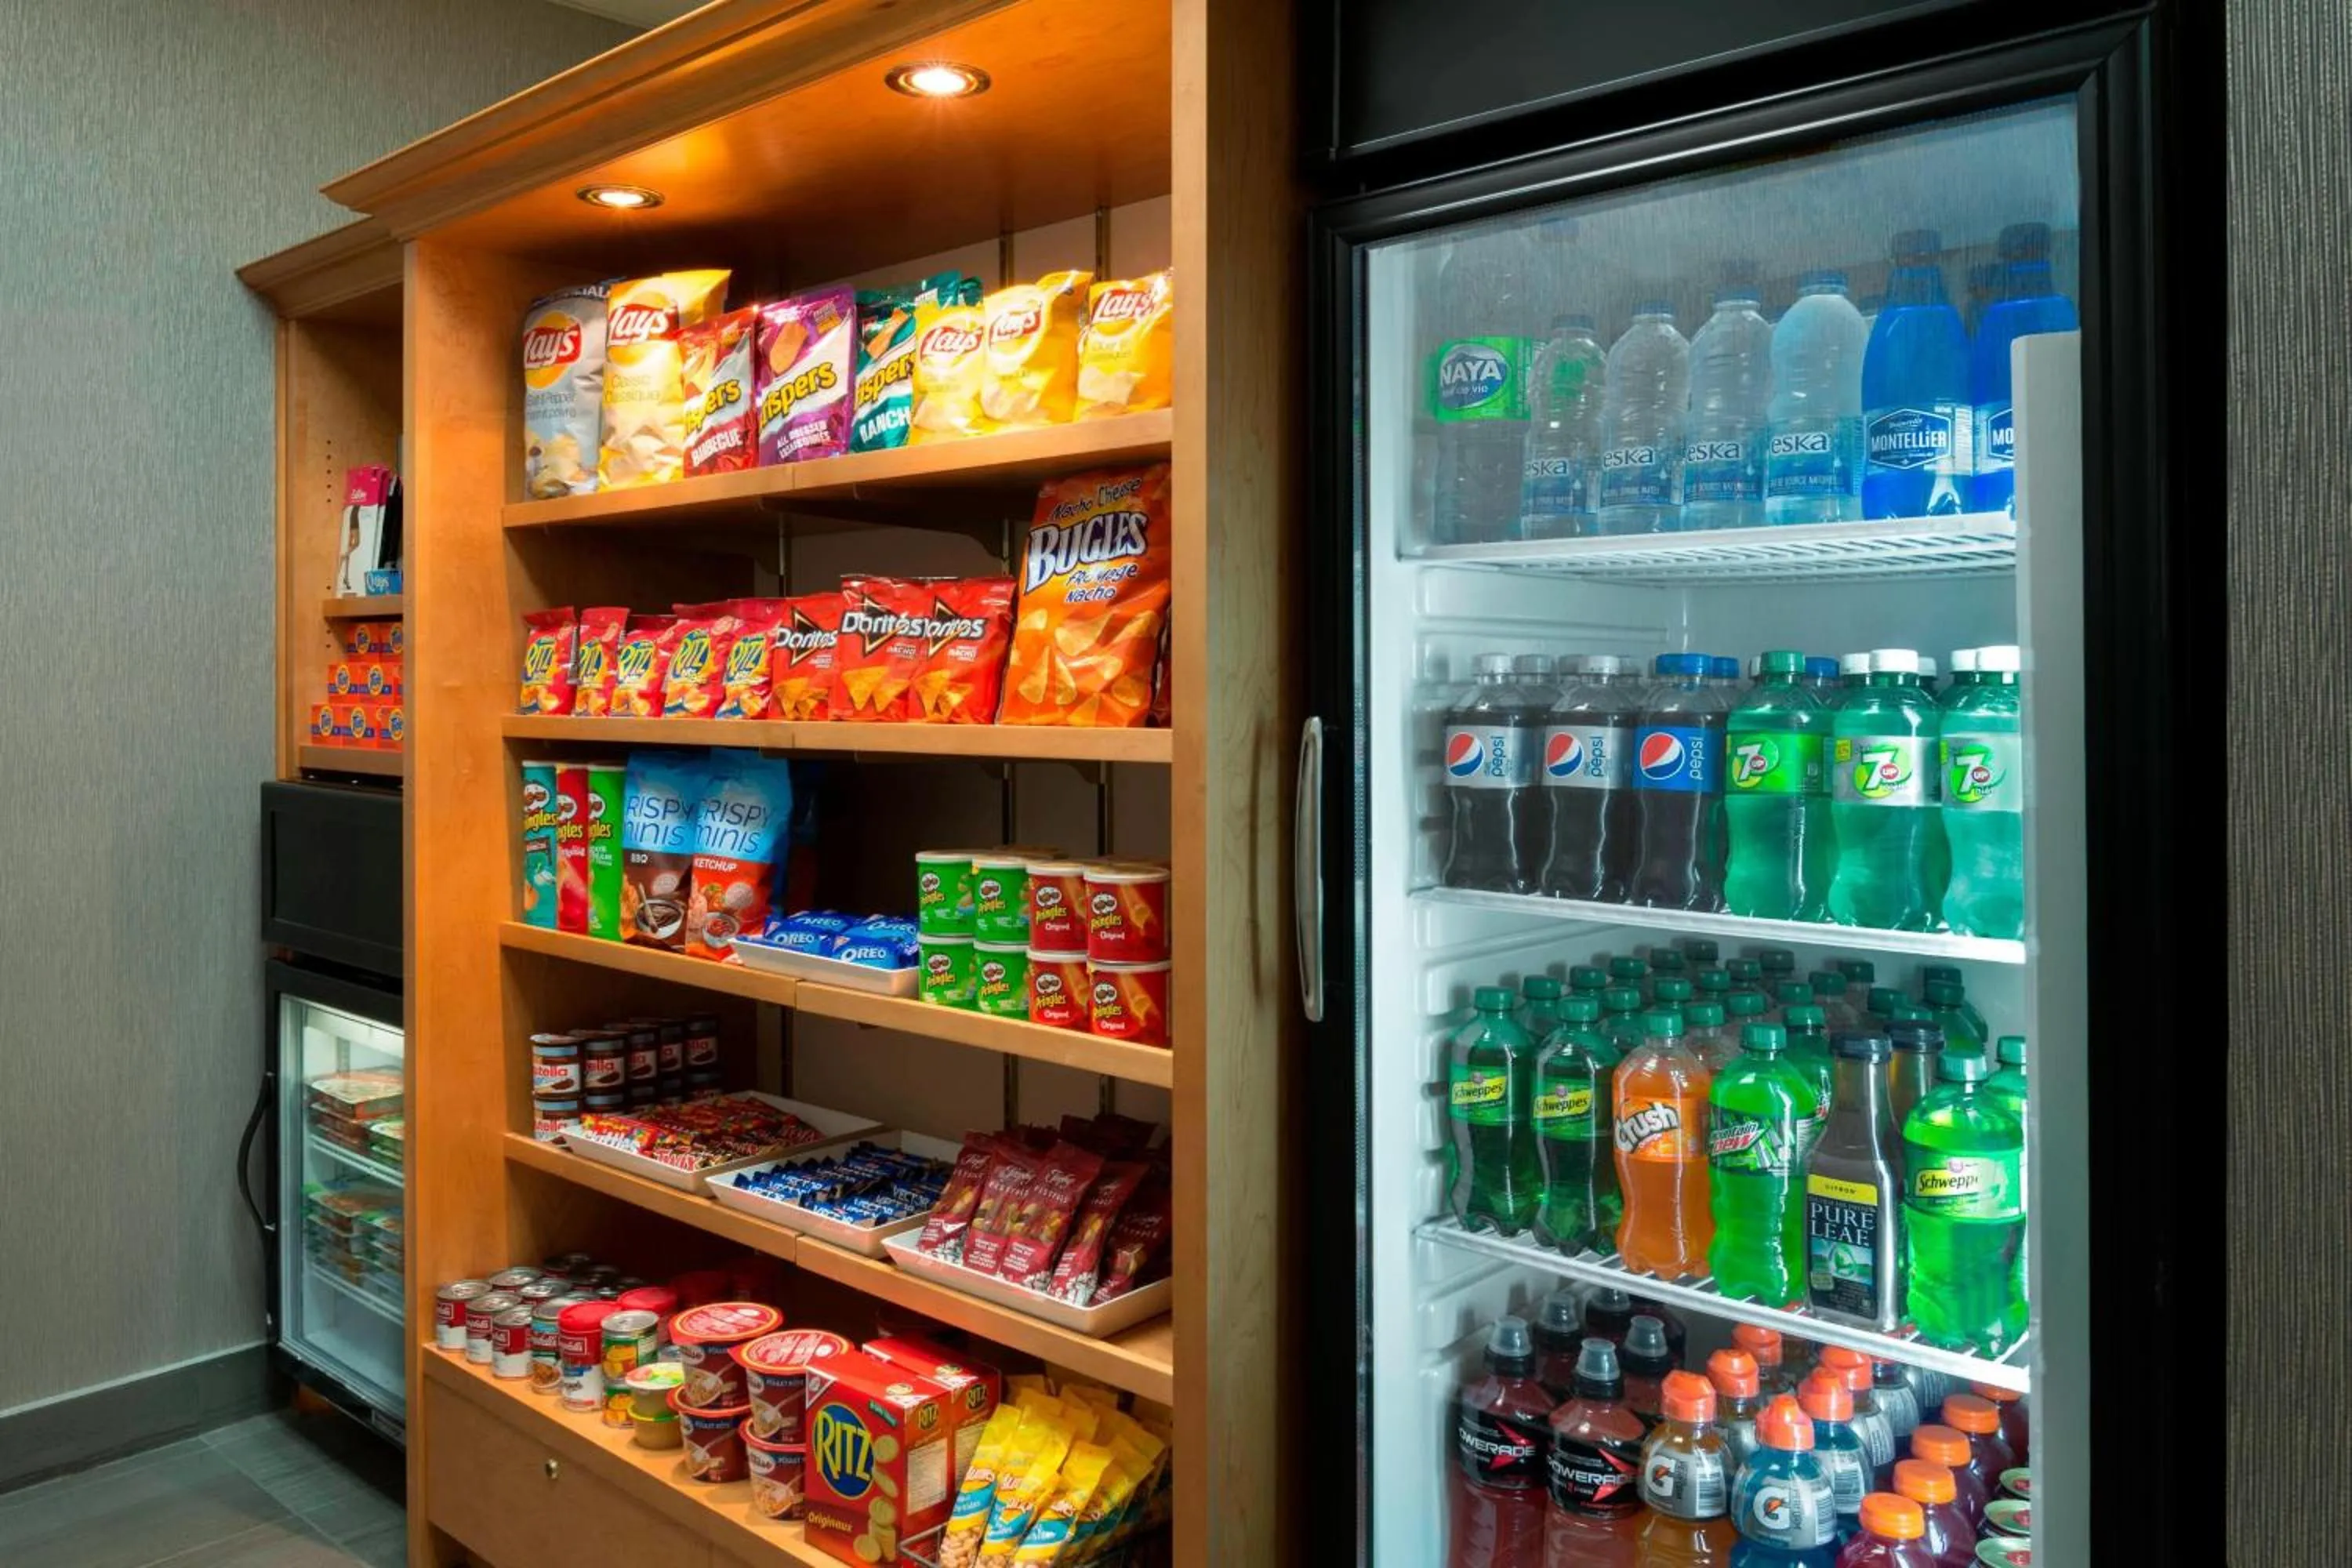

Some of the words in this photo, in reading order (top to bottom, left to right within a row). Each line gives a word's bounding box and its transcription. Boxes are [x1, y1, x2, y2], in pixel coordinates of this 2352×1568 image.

[1441, 359, 1502, 387] NAYA
[1688, 441, 1741, 461] eska
[1771, 432, 1829, 454] eska
[1603, 447, 1654, 469] eska
[1025, 511, 1149, 594] BUGLES
[774, 623, 839, 649] Doritos
[1490, 735, 1506, 777] pepsi
[1590, 735, 1606, 777] pepsi
[1688, 735, 1706, 780] pepsi
[693, 857, 738, 871] KETCHUP
[774, 931, 815, 945] OREO
[840, 947, 887, 963] OREO
[1615, 1101, 1679, 1153] Crush
[1810, 1202, 1876, 1231] PURE
[1811, 1219, 1871, 1247] LEAF
[815, 1409, 873, 1482] RITZ
